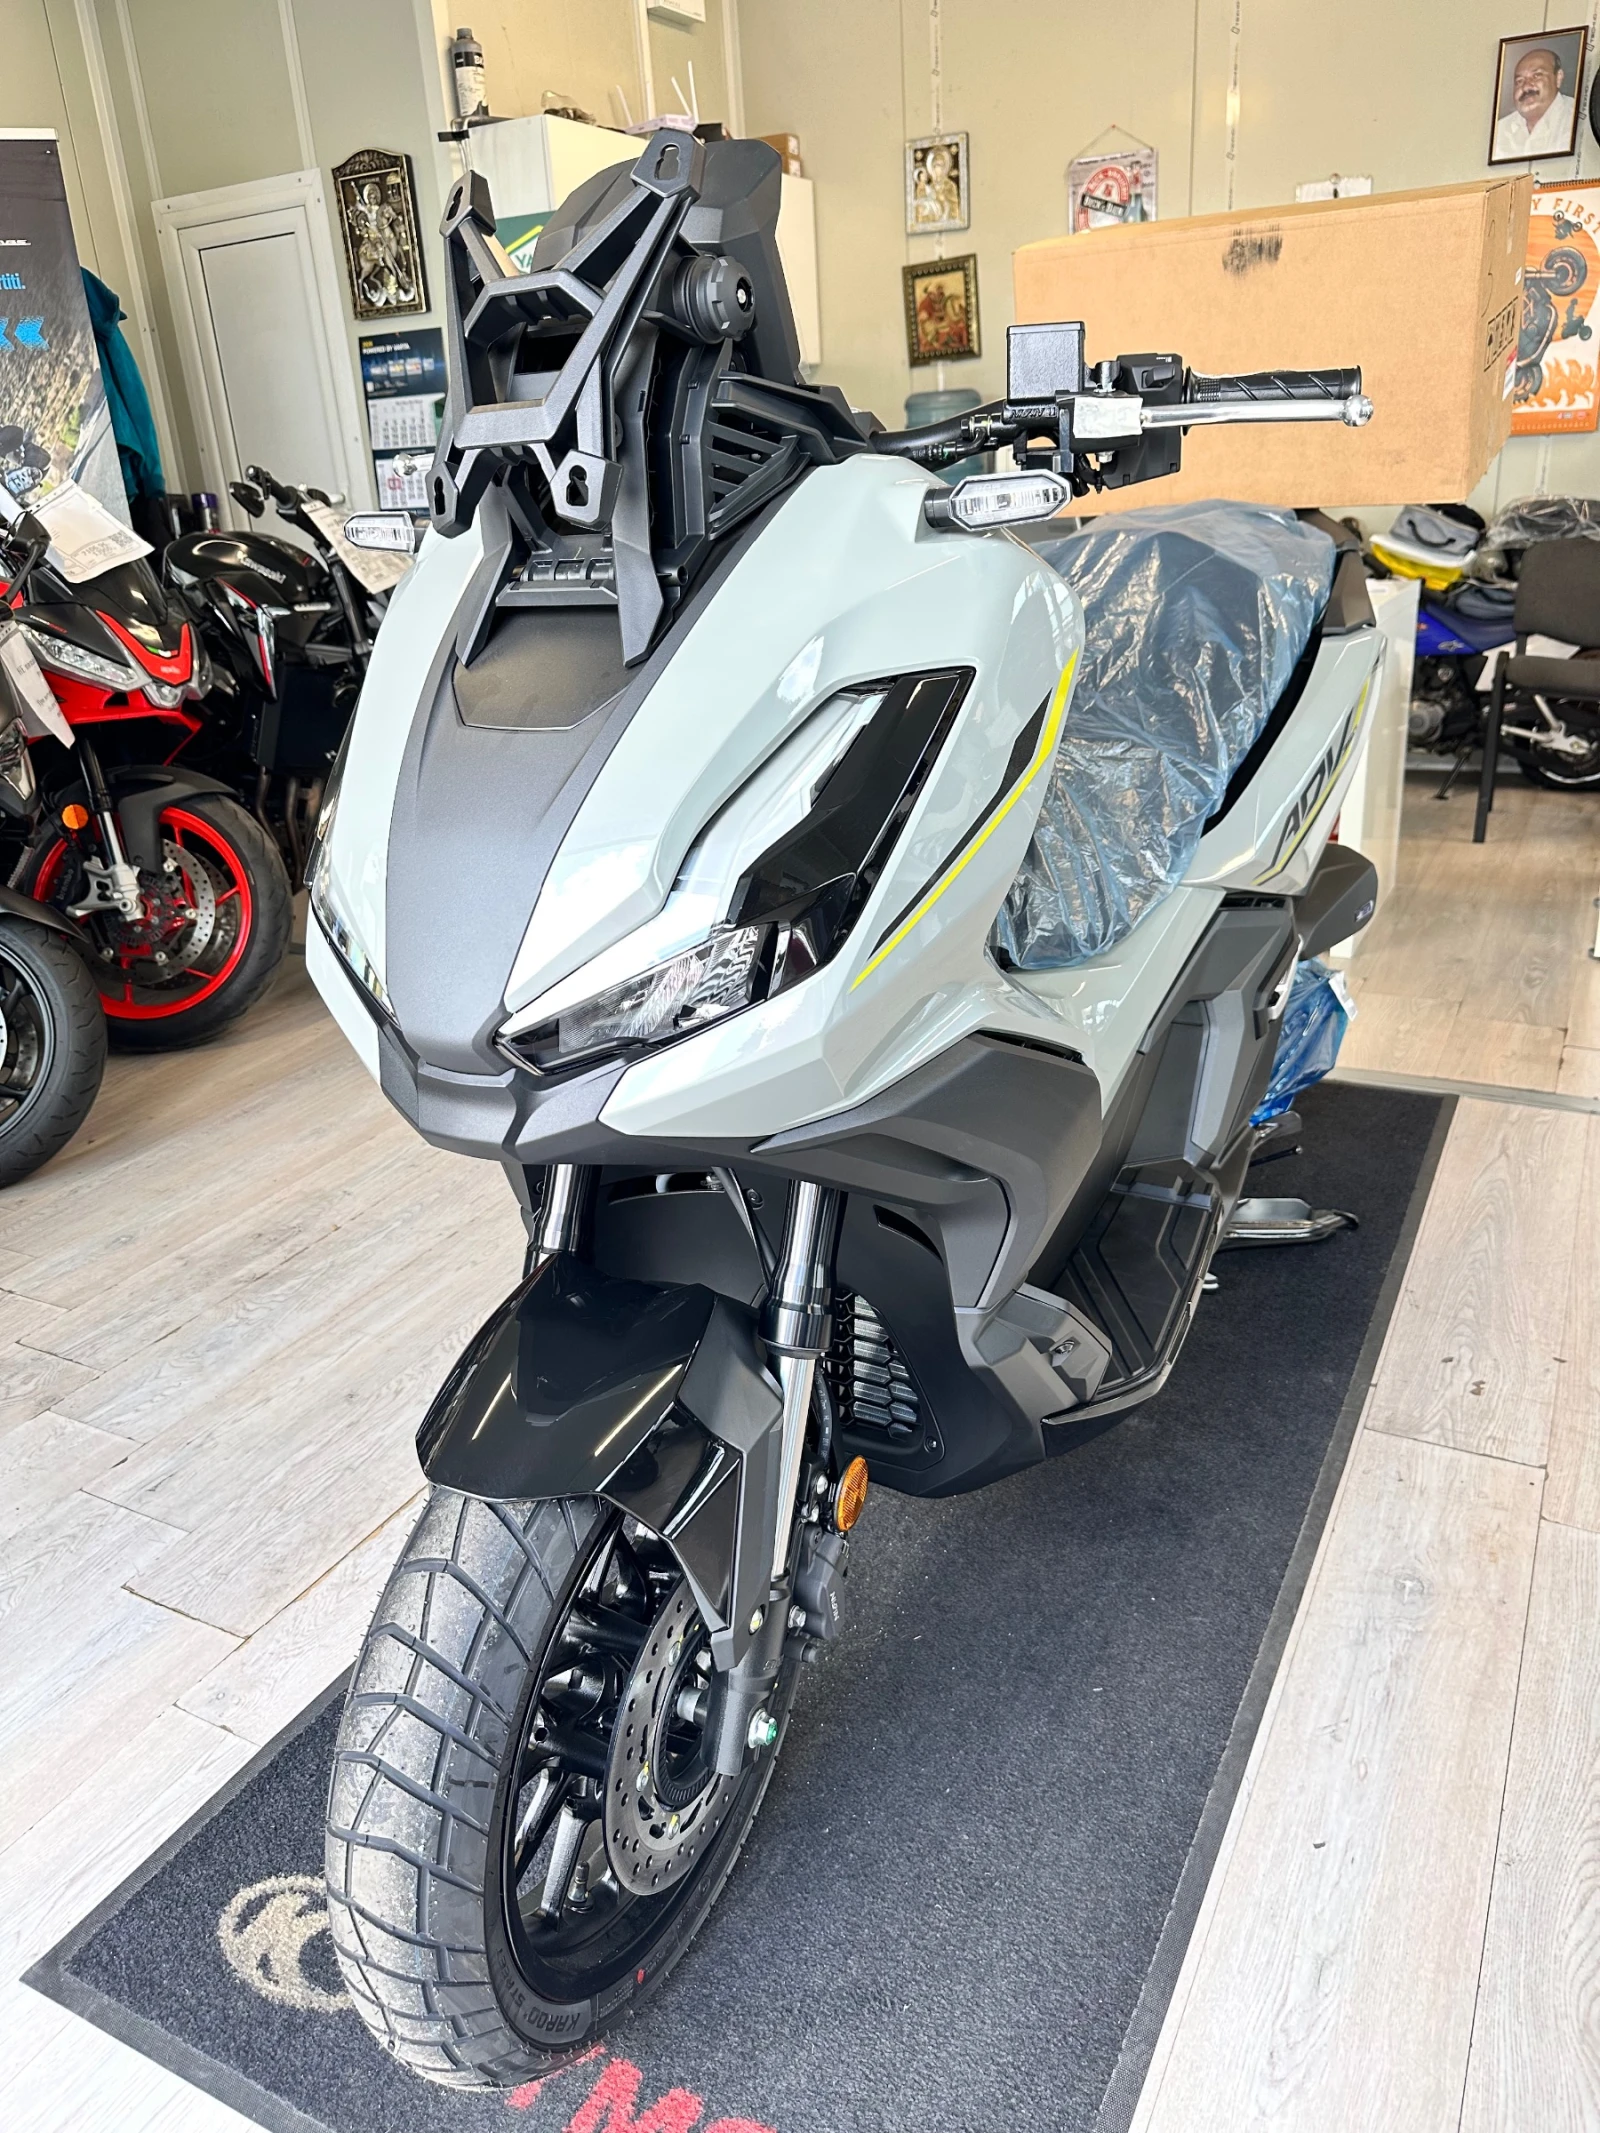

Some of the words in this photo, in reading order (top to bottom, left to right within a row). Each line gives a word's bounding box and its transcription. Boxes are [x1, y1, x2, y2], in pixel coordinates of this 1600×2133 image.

[1552, 197, 1600, 234] FIRST
[495, 1947, 526, 2008] STREET
[527, 2005, 581, 2033] KAROO
